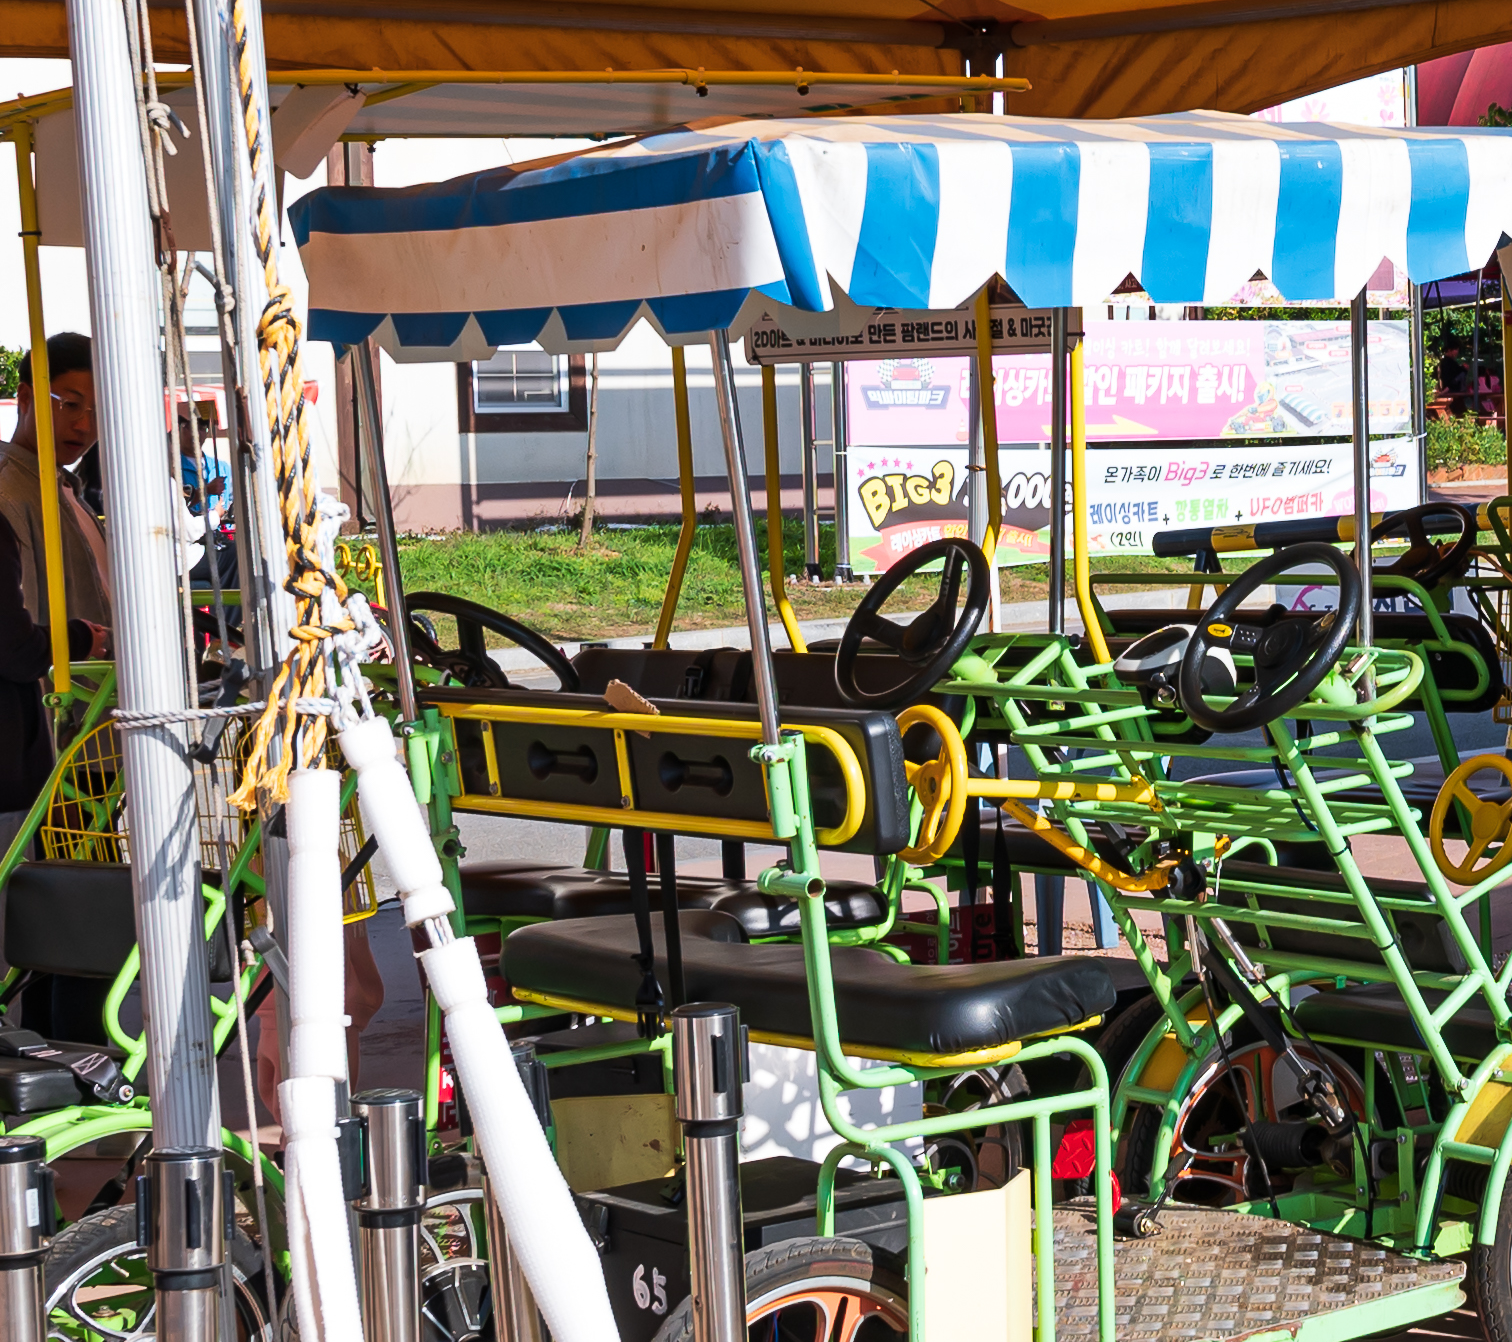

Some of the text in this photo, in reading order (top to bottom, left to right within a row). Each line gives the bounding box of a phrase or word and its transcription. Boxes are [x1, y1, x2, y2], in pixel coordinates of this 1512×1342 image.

[1124, 365, 1247, 404] 패키지 출시!
[1104, 459, 1332, 486] 온가족이 Big3 로 한번에 즐기세요!
[859, 460, 954, 530] BIG3
[1089, 501, 1158, 525] 레이싱카트
[633, 1264, 667, 1315] 65
